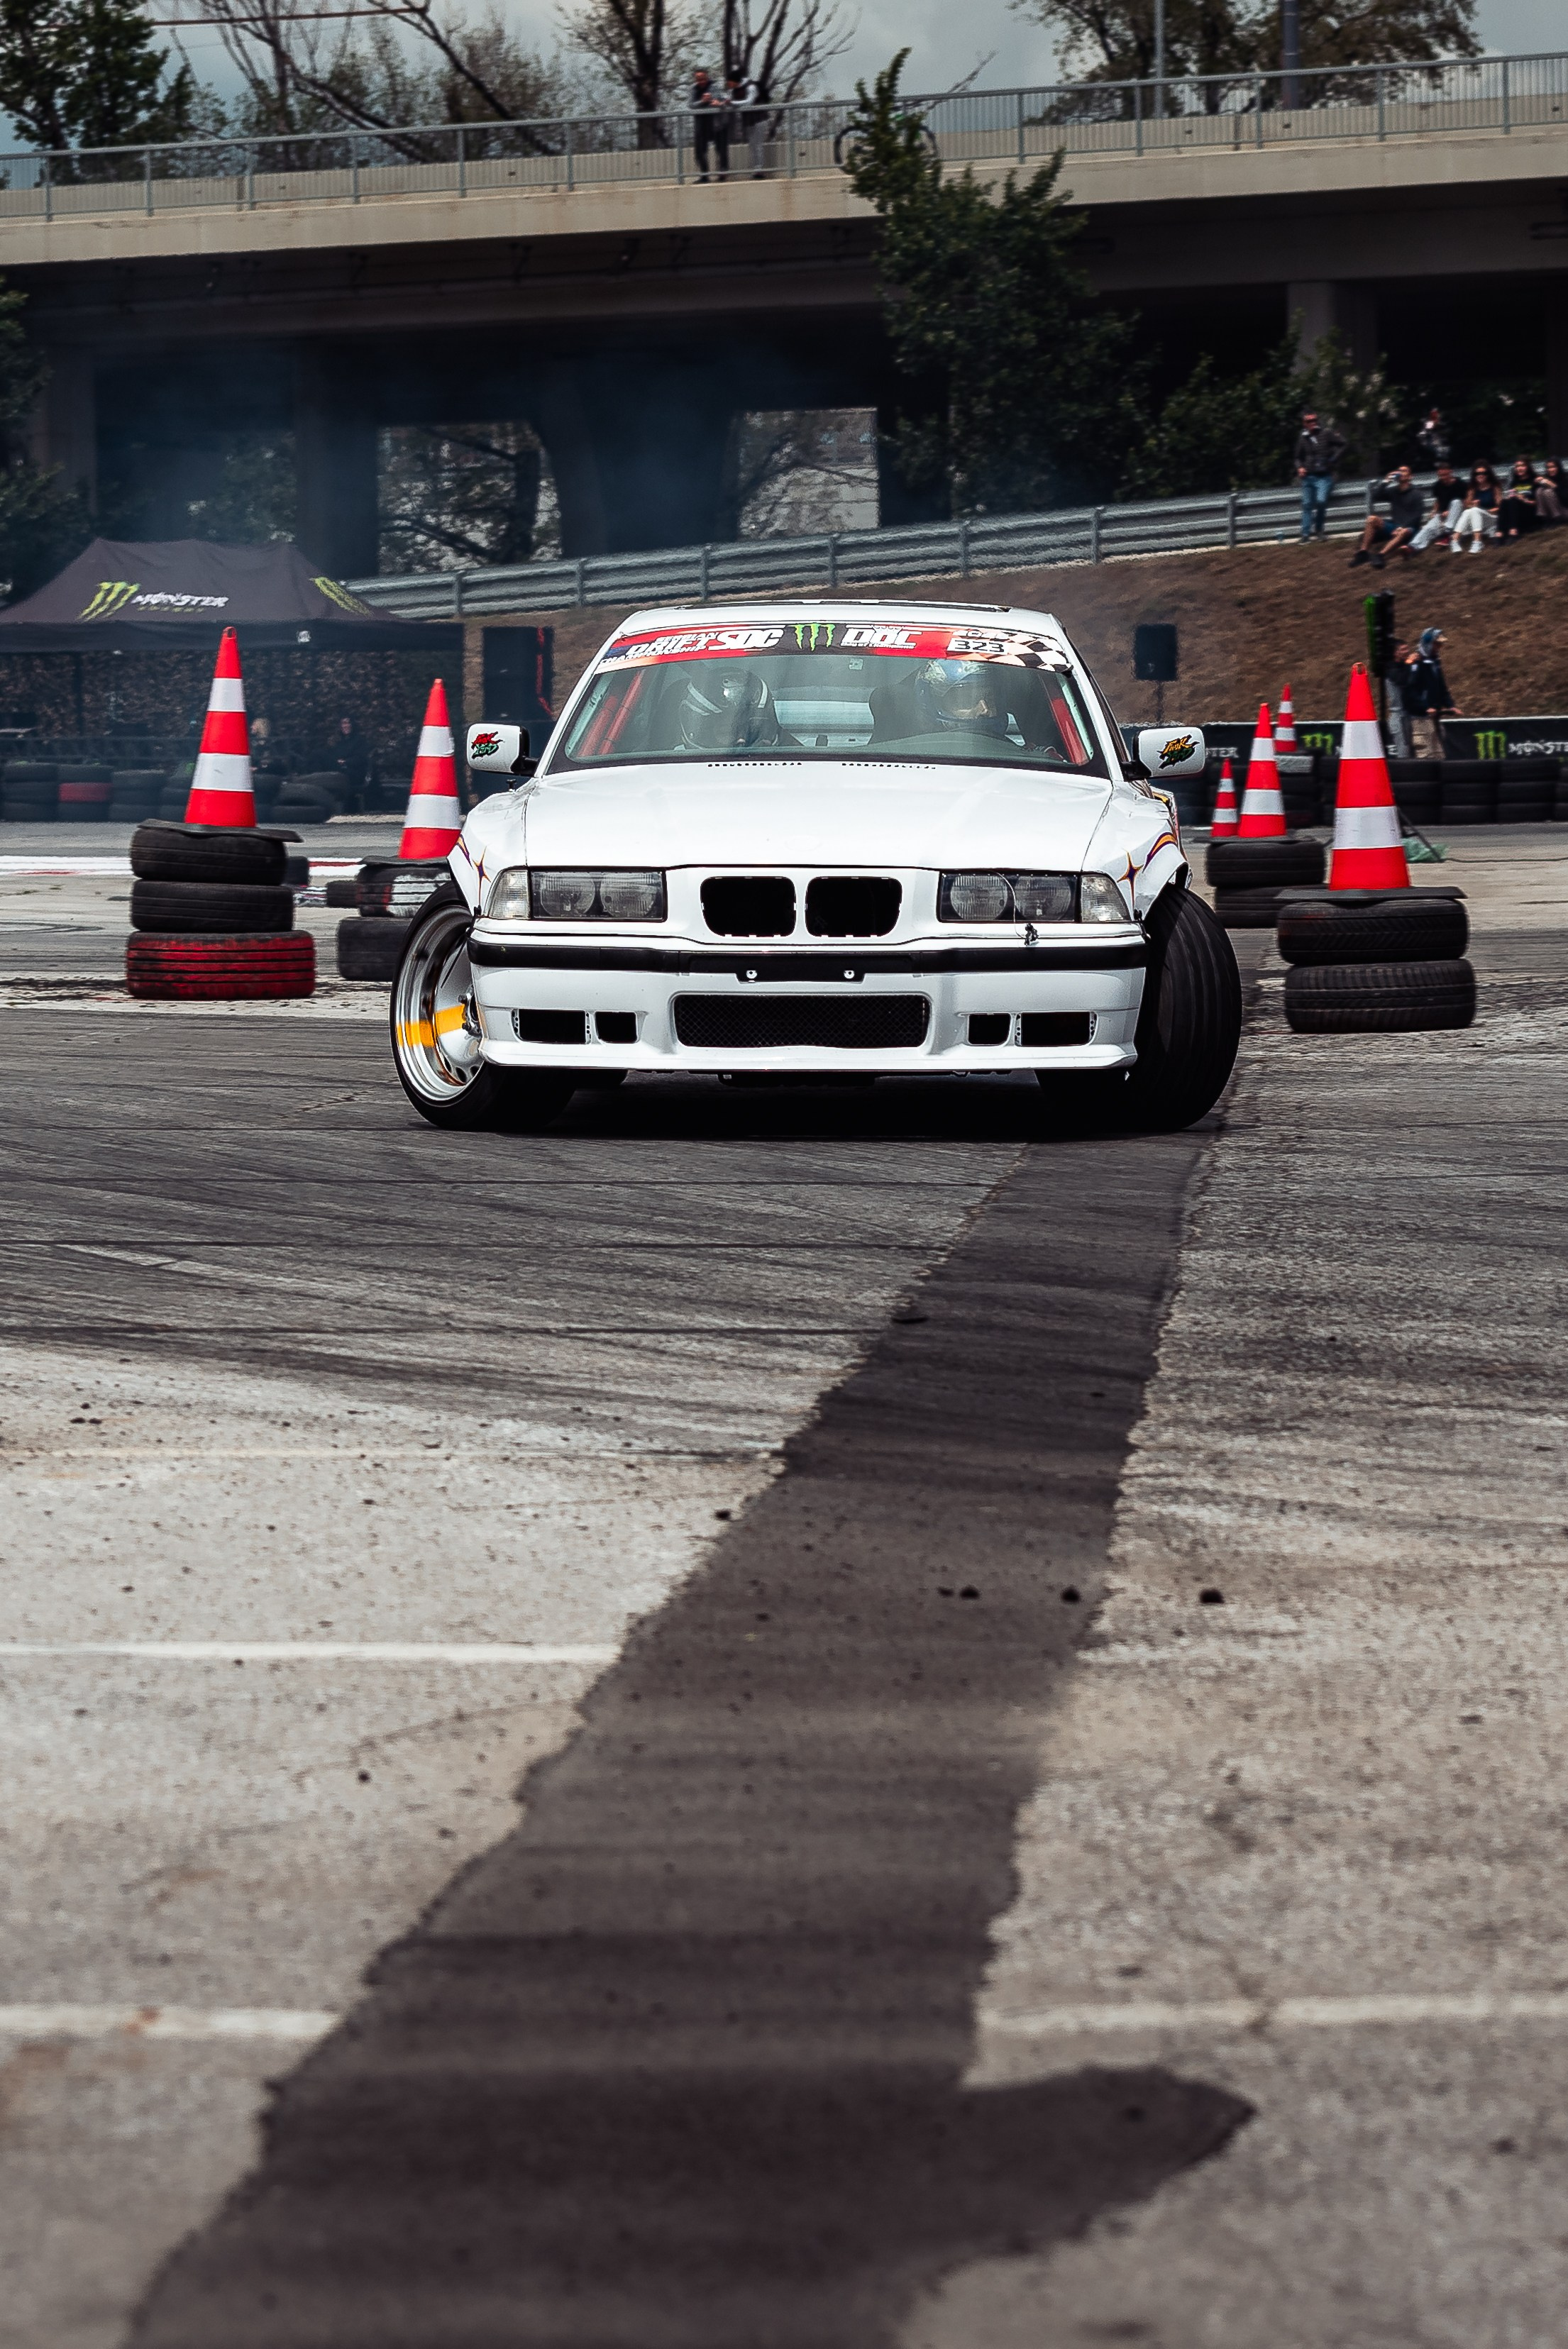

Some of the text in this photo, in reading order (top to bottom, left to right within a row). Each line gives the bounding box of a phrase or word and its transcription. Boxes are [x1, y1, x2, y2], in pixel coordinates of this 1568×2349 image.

[625, 636, 712, 656] DRIFT
[708, 628, 784, 651] SDC
[954, 639, 1005, 653] 323
[600, 646, 707, 663] CHAMPIONSHIP
